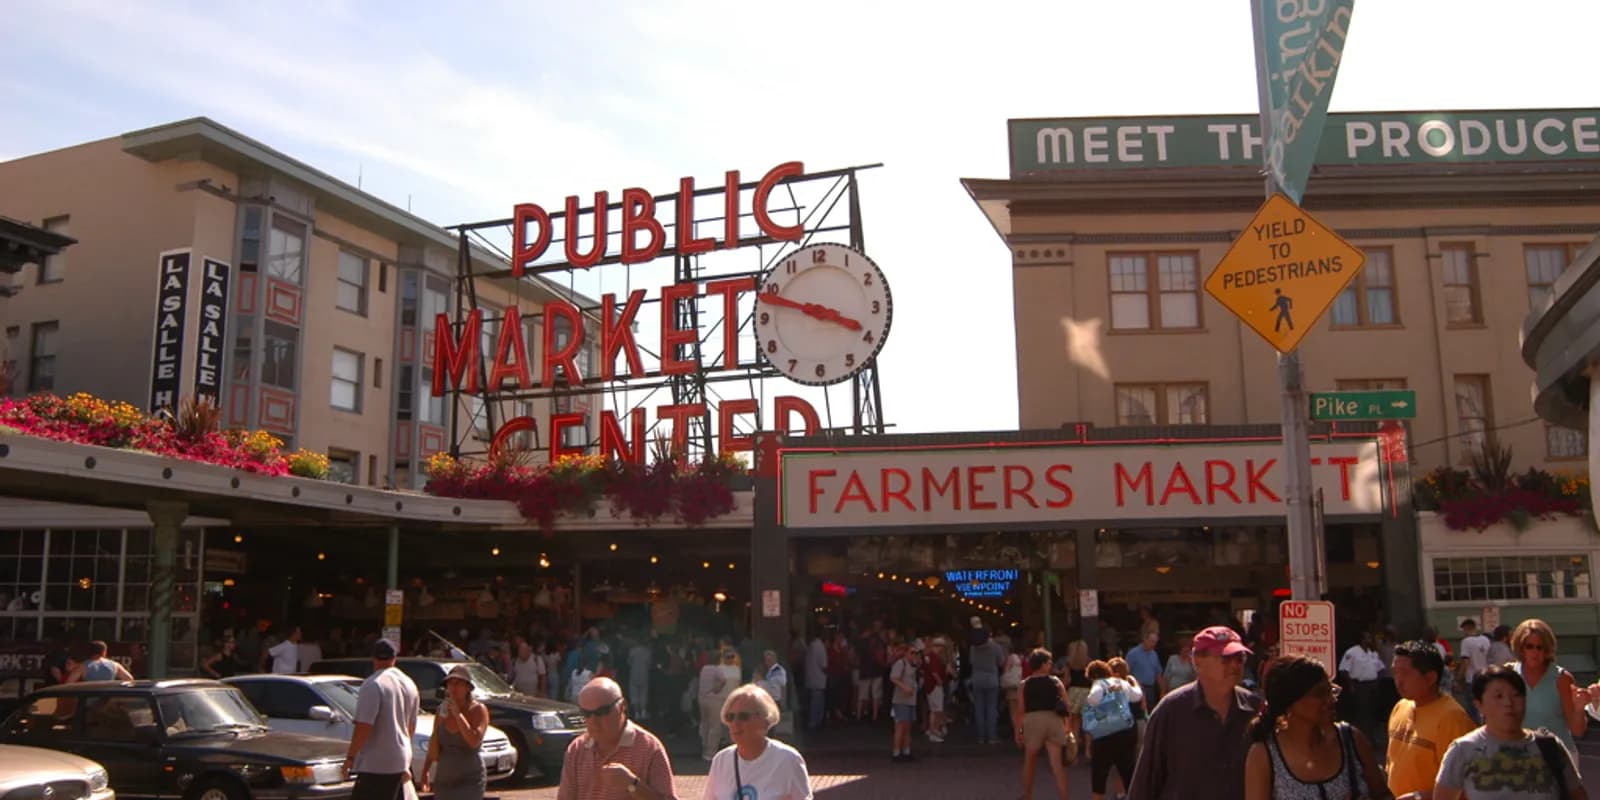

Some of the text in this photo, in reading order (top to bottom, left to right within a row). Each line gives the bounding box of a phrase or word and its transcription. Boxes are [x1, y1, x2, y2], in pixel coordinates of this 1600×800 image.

[1036, 117, 1600, 164] MEET TH PRODUCE
[511, 161, 805, 277] PUBLIC
[1253, 218, 1306, 242] YIELD
[812, 249, 826, 265] 12
[1268, 242, 1291, 260] TO
[786, 259, 797, 275] 11
[844, 253, 849, 268] 1
[163, 259, 183, 290] LA
[206, 263, 224, 297] LA
[863, 273, 873, 286] 2
[1223, 255, 1344, 290] PEDESTRIANS
[766, 282, 780, 296] 10
[871, 300, 881, 315] 3
[760, 312, 770, 326] 9
[157, 296, 181, 379] SALLE
[431, 276, 757, 397] MARKET
[862, 330, 874, 344] 4
[199, 305, 222, 386] SALLE
[767, 339, 777, 354] 8
[787, 359, 798, 373] 7
[845, 353, 855, 367] 5
[815, 363, 826, 378] 6
[1315, 397, 1359, 416] Pike
[808, 456, 1360, 514] FARMERS MARKT
[1284, 604, 1305, 617] NO
[1285, 623, 1329, 636] STOPS
